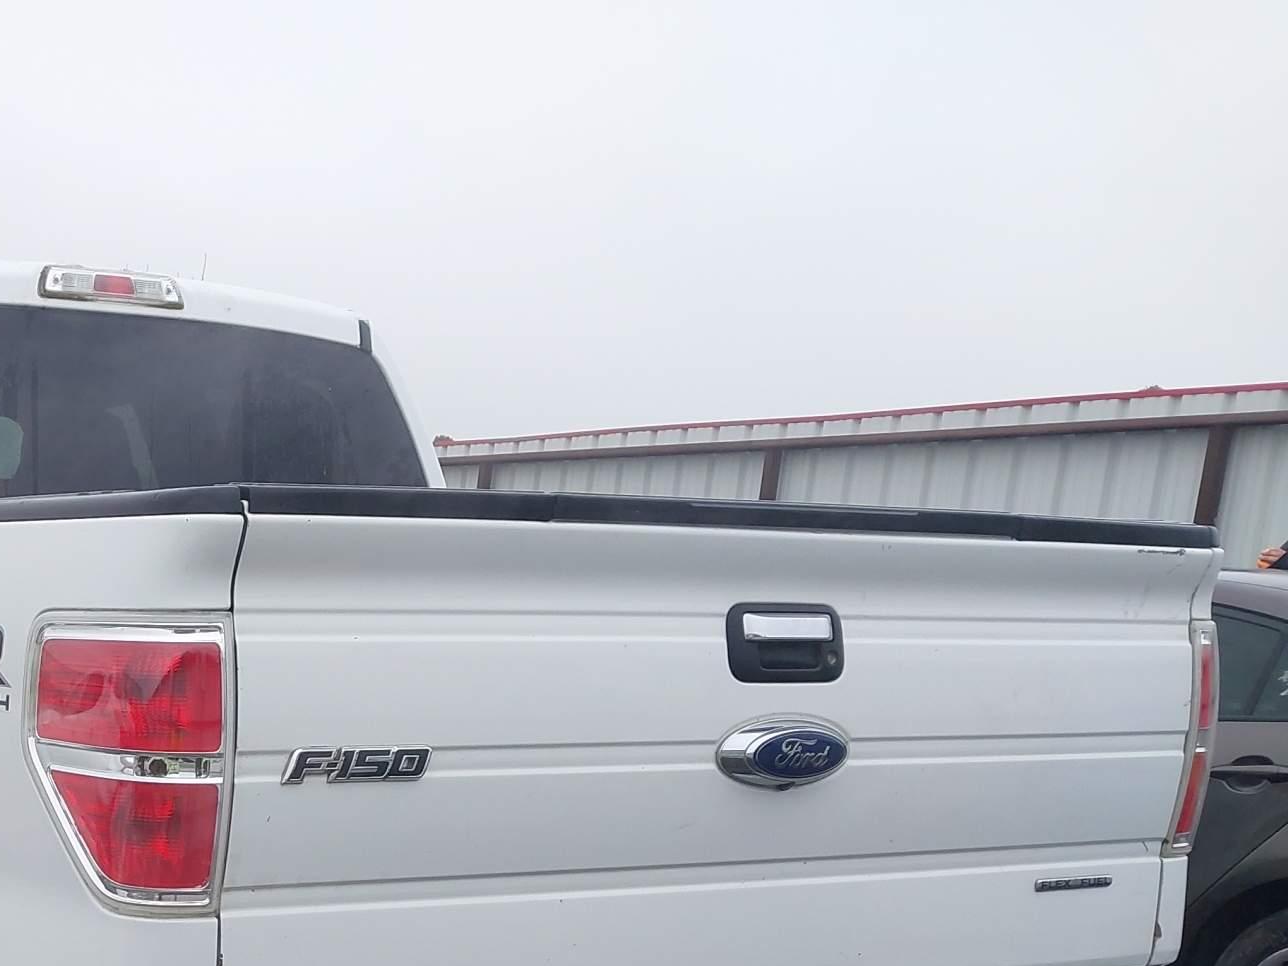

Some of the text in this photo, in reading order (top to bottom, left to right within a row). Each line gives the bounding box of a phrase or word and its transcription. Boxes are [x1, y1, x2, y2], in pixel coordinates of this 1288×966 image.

[281, 745, 433, 784] F-150
[774, 737, 831, 768] Ford
[1040, 879, 1072, 890] FLEX
